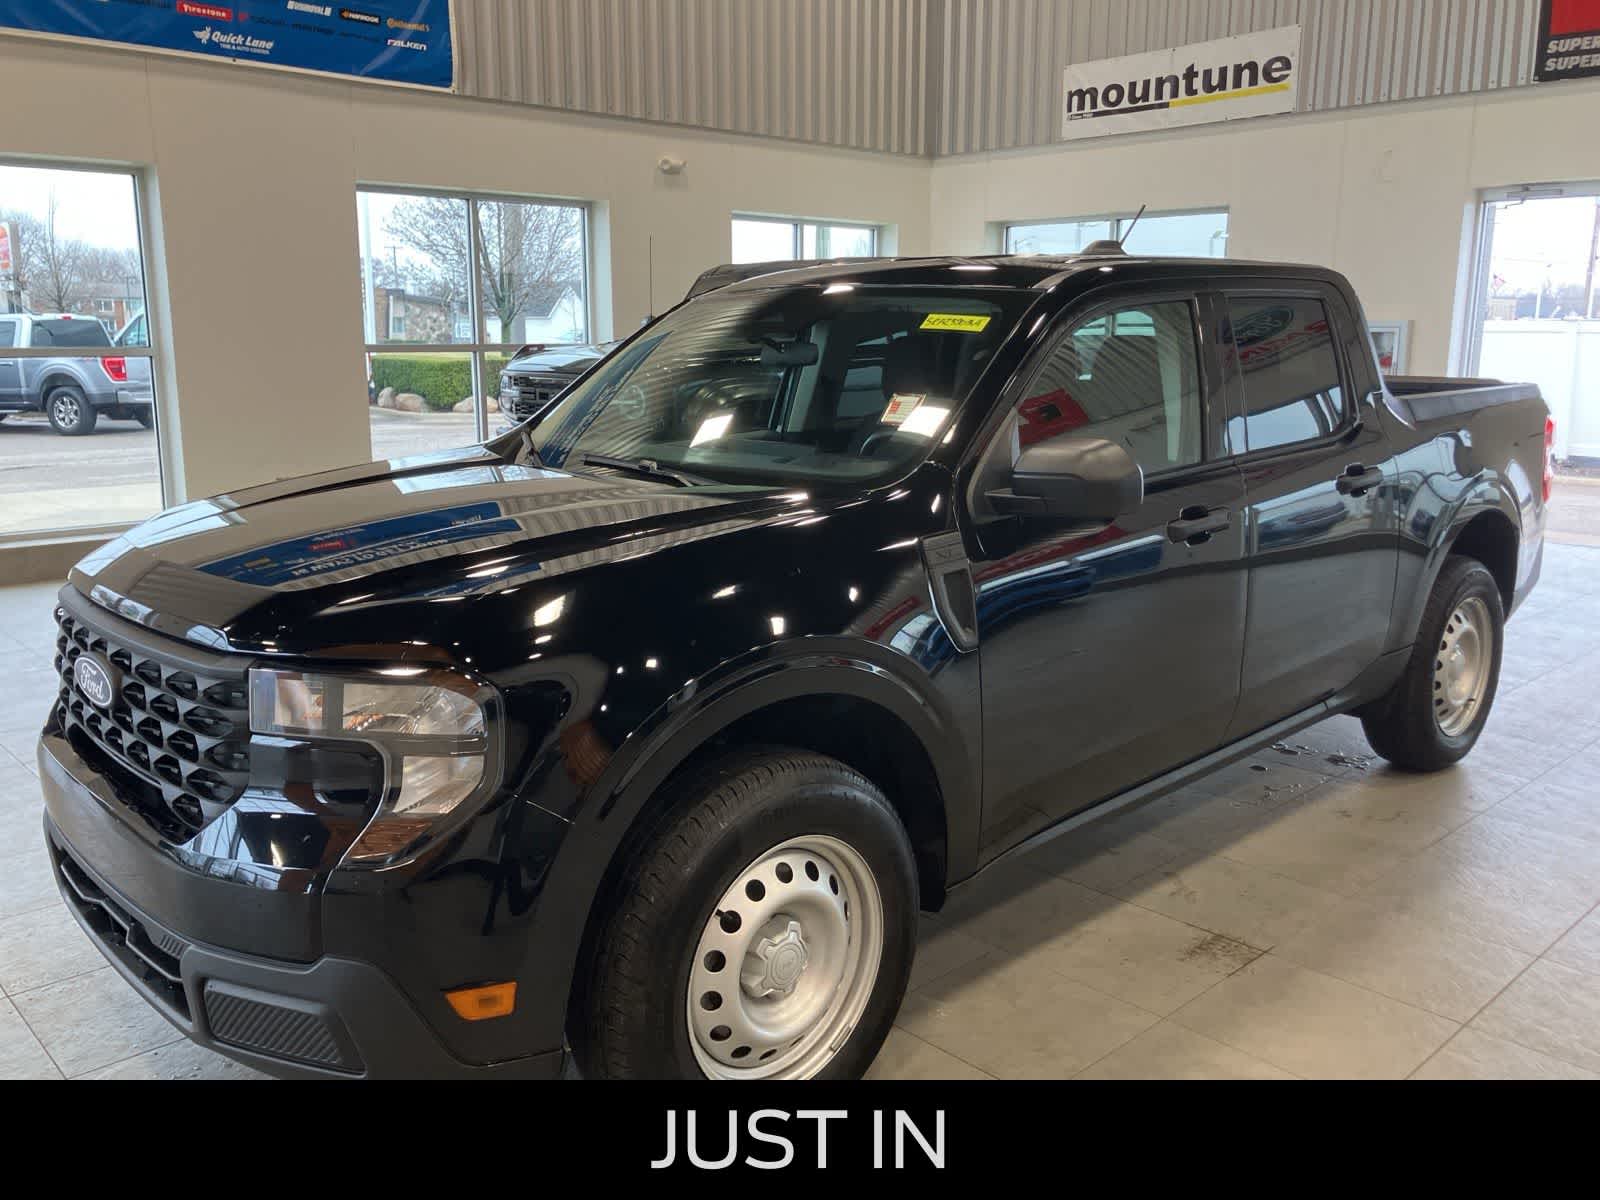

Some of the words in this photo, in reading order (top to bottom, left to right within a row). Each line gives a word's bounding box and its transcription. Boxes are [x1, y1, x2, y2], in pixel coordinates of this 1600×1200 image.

[211, 31, 245, 44] Quick
[245, 36, 275, 50] Lane
[387, 39, 427, 51] FALKEN
[1066, 55, 1292, 113] mountune
[80, 662, 104, 699] Ford
